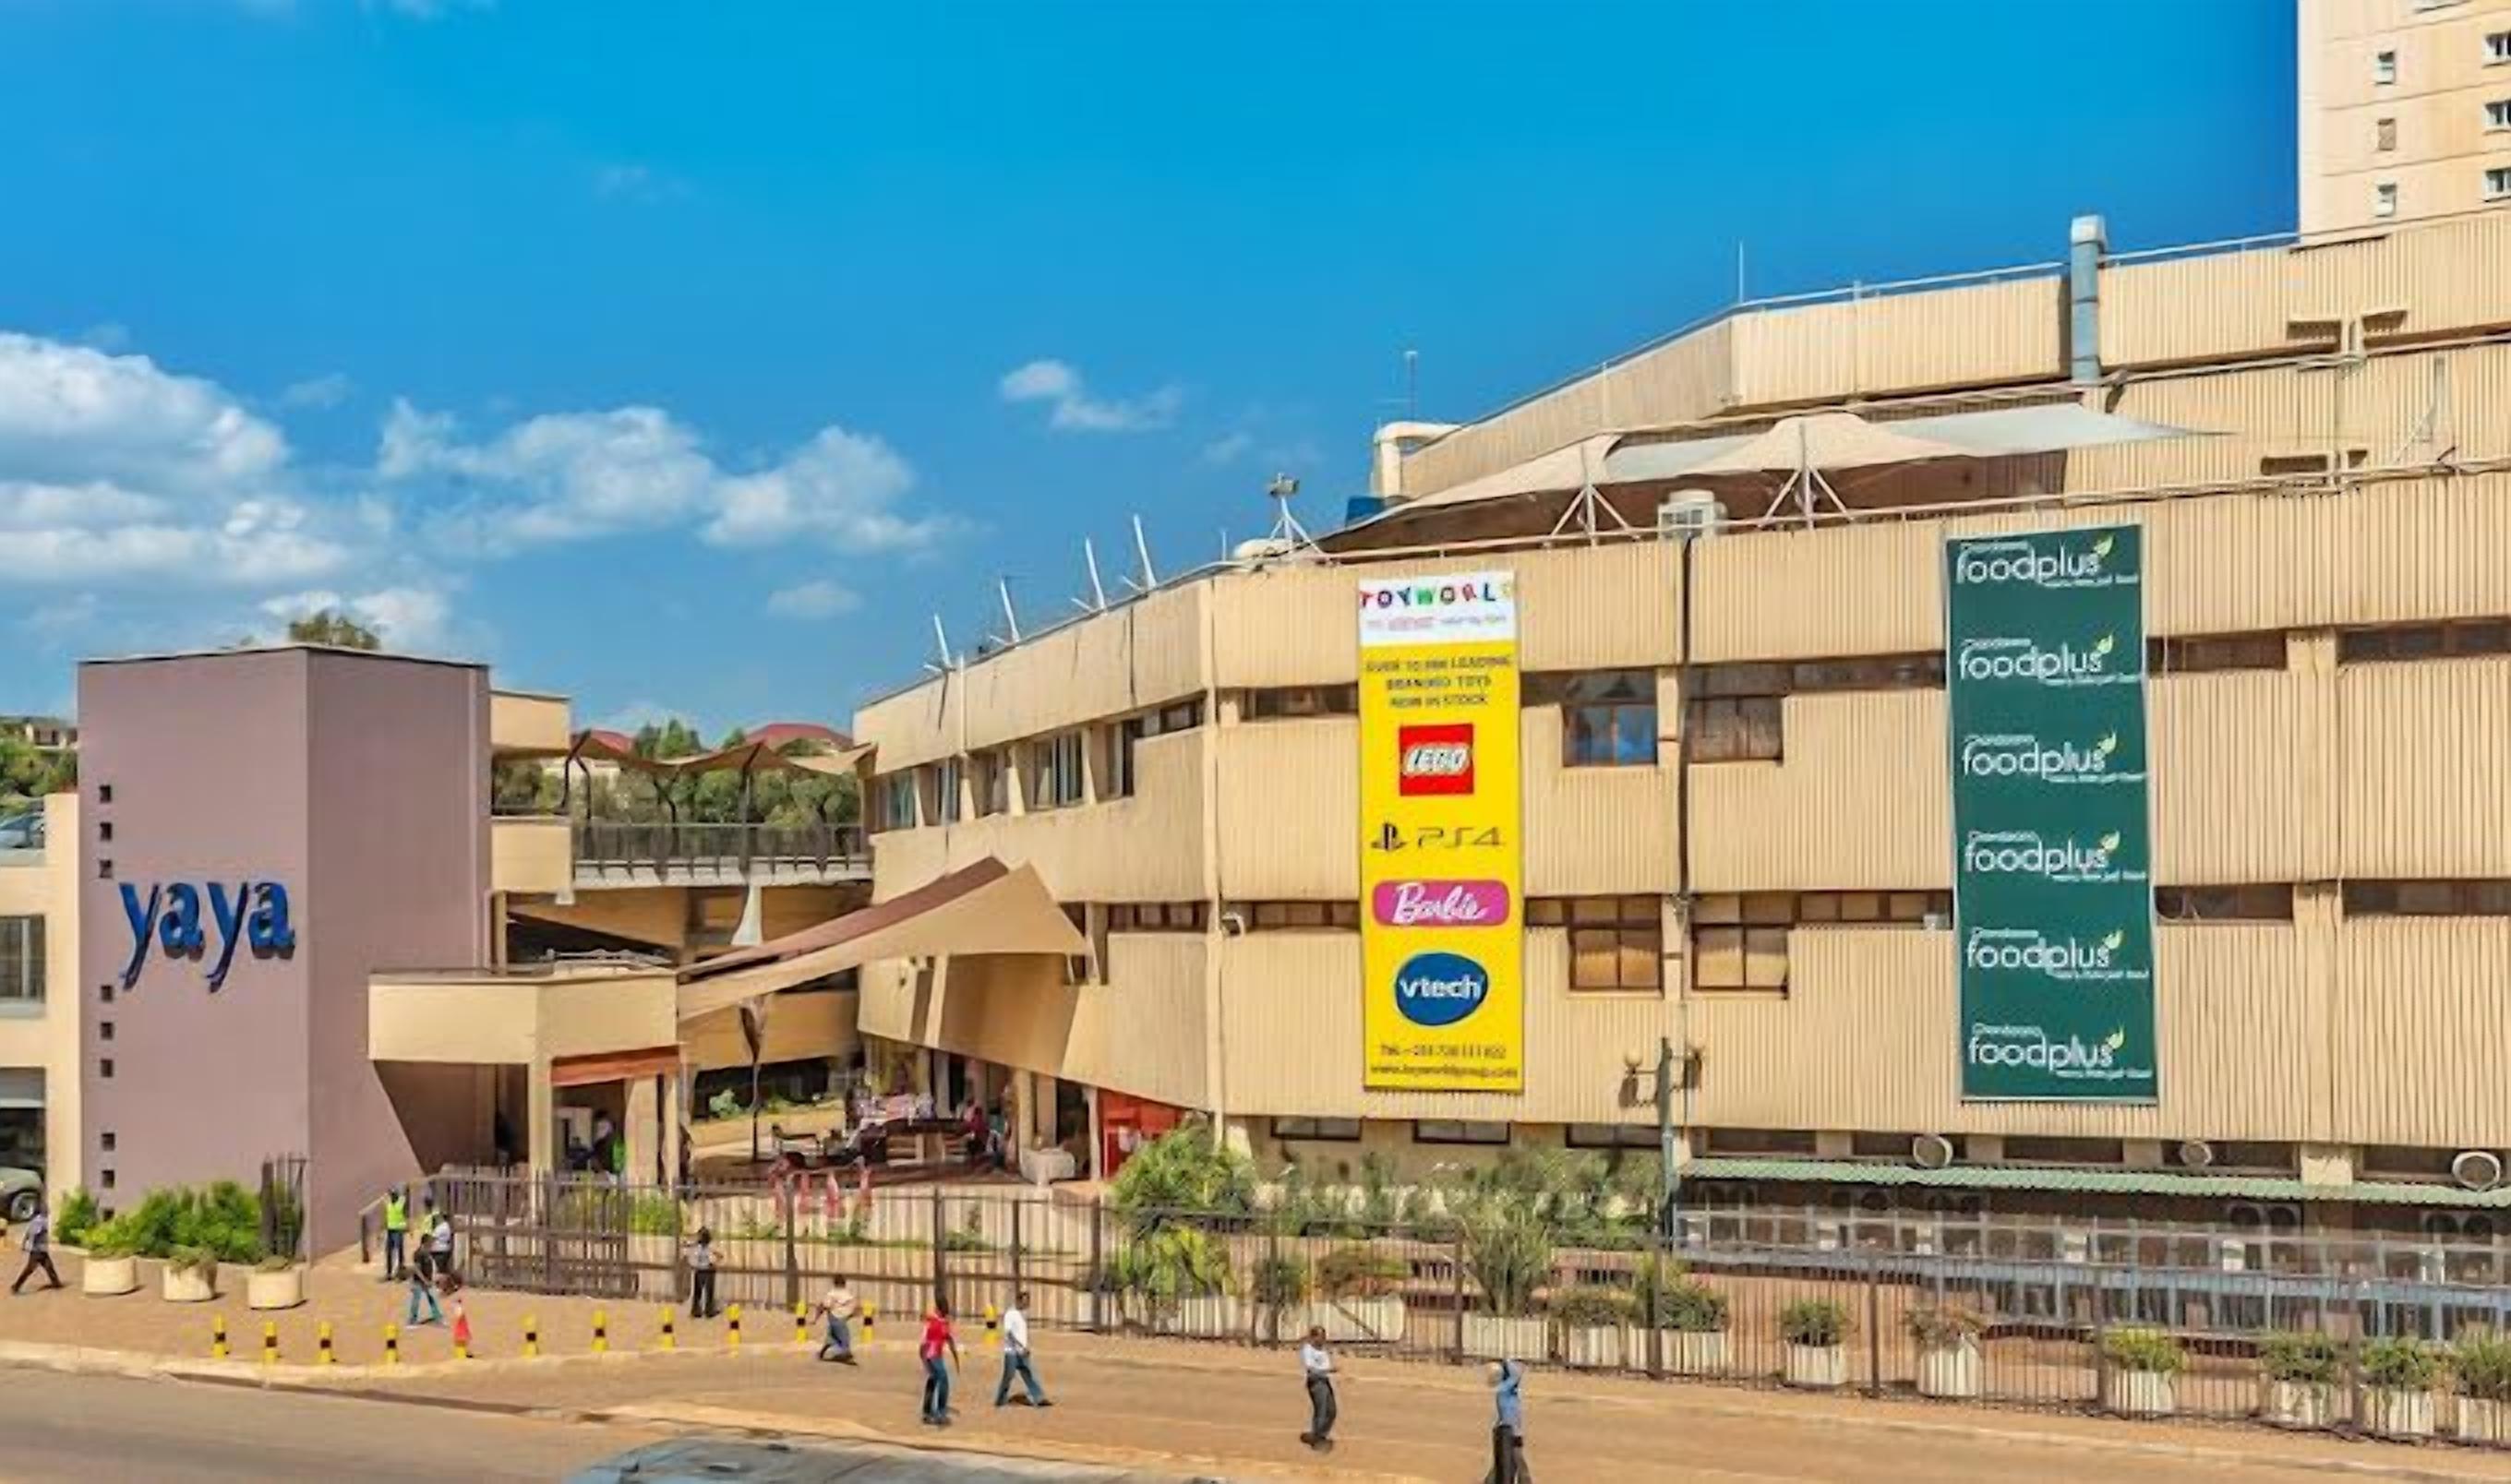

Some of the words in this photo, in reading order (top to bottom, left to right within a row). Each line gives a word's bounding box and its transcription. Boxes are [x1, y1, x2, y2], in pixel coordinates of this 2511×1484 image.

[1956, 543, 2102, 584] foodplus
[1959, 642, 2103, 680] foodplus
[1962, 740, 2106, 779] foodplus
[1418, 827, 1502, 848] PS4
[1964, 837, 2109, 876] foodplus
[1392, 881, 1489, 924] Barbie
[119, 881, 296, 993] yaya
[1967, 936, 2109, 975] foodplus
[1400, 975, 1482, 999] vtech
[1969, 1033, 2113, 1073] foodplus
